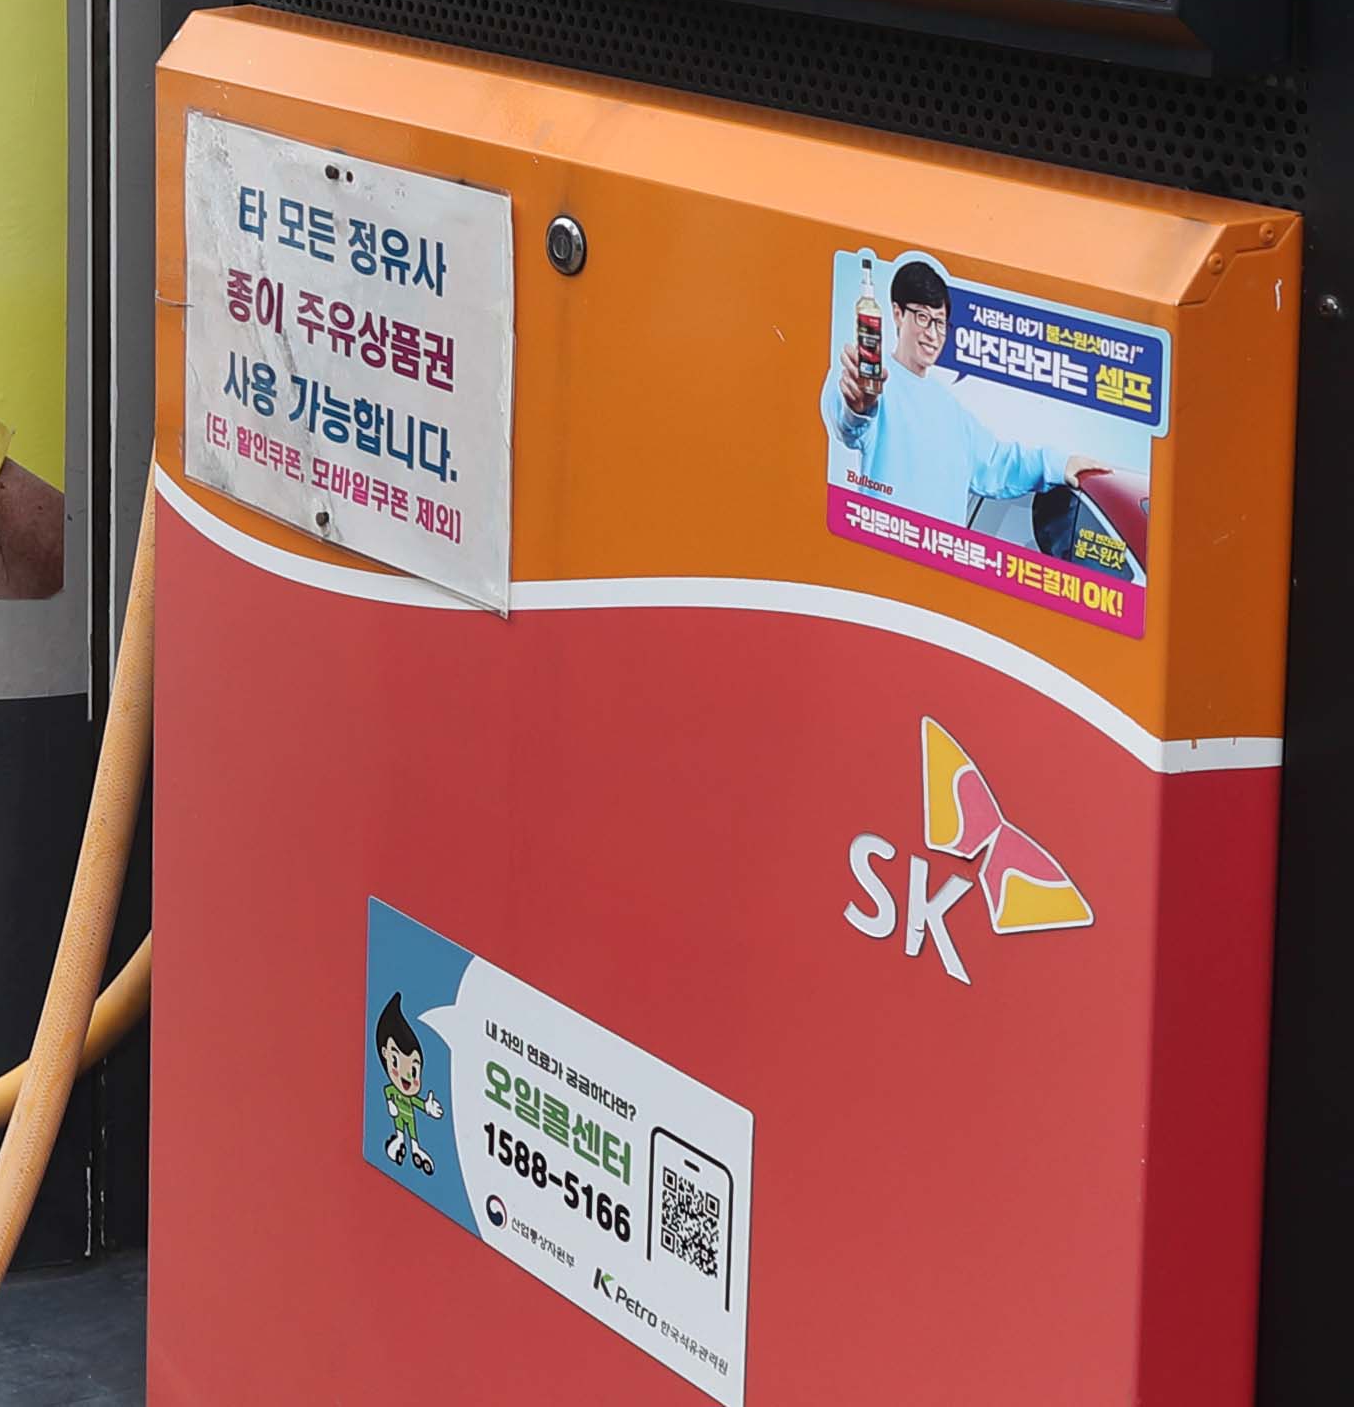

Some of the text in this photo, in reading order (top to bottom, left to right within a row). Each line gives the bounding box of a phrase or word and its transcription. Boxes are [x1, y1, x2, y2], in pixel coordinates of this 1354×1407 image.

[239, 185, 447, 296] 타 모든 정유사
[226, 268, 456, 392] 종이 주유상품권
[955, 327, 1152, 414] 엔진관리는 셀프
[1016, 315, 1043, 341] 여기
[223, 351, 459, 483] 사용 가능합니다.
[236, 425, 305, 483] 할인쿠폰,
[311, 459, 409, 522] 모바일쿠폰
[846, 469, 894, 495] Bullsone
[845, 500, 920, 549] 구입문의는
[1006, 554, 1081, 604] 카드결제
[1083, 580, 1124, 619] OK!
[1074, 539, 1125, 571] 불스원샷
[843, 832, 974, 986] SK
[485, 1019, 637, 1122] 내 차의 연료가 궁금하다면?
[484, 1060, 632, 1186] 오일콜센터
[483, 1122, 632, 1243] 1588-5166
[511, 1217, 576, 1269] 산업통상자원부
[615, 1286, 658, 1328] Petro
[660, 1320, 729, 1376] 한국석유관리원
